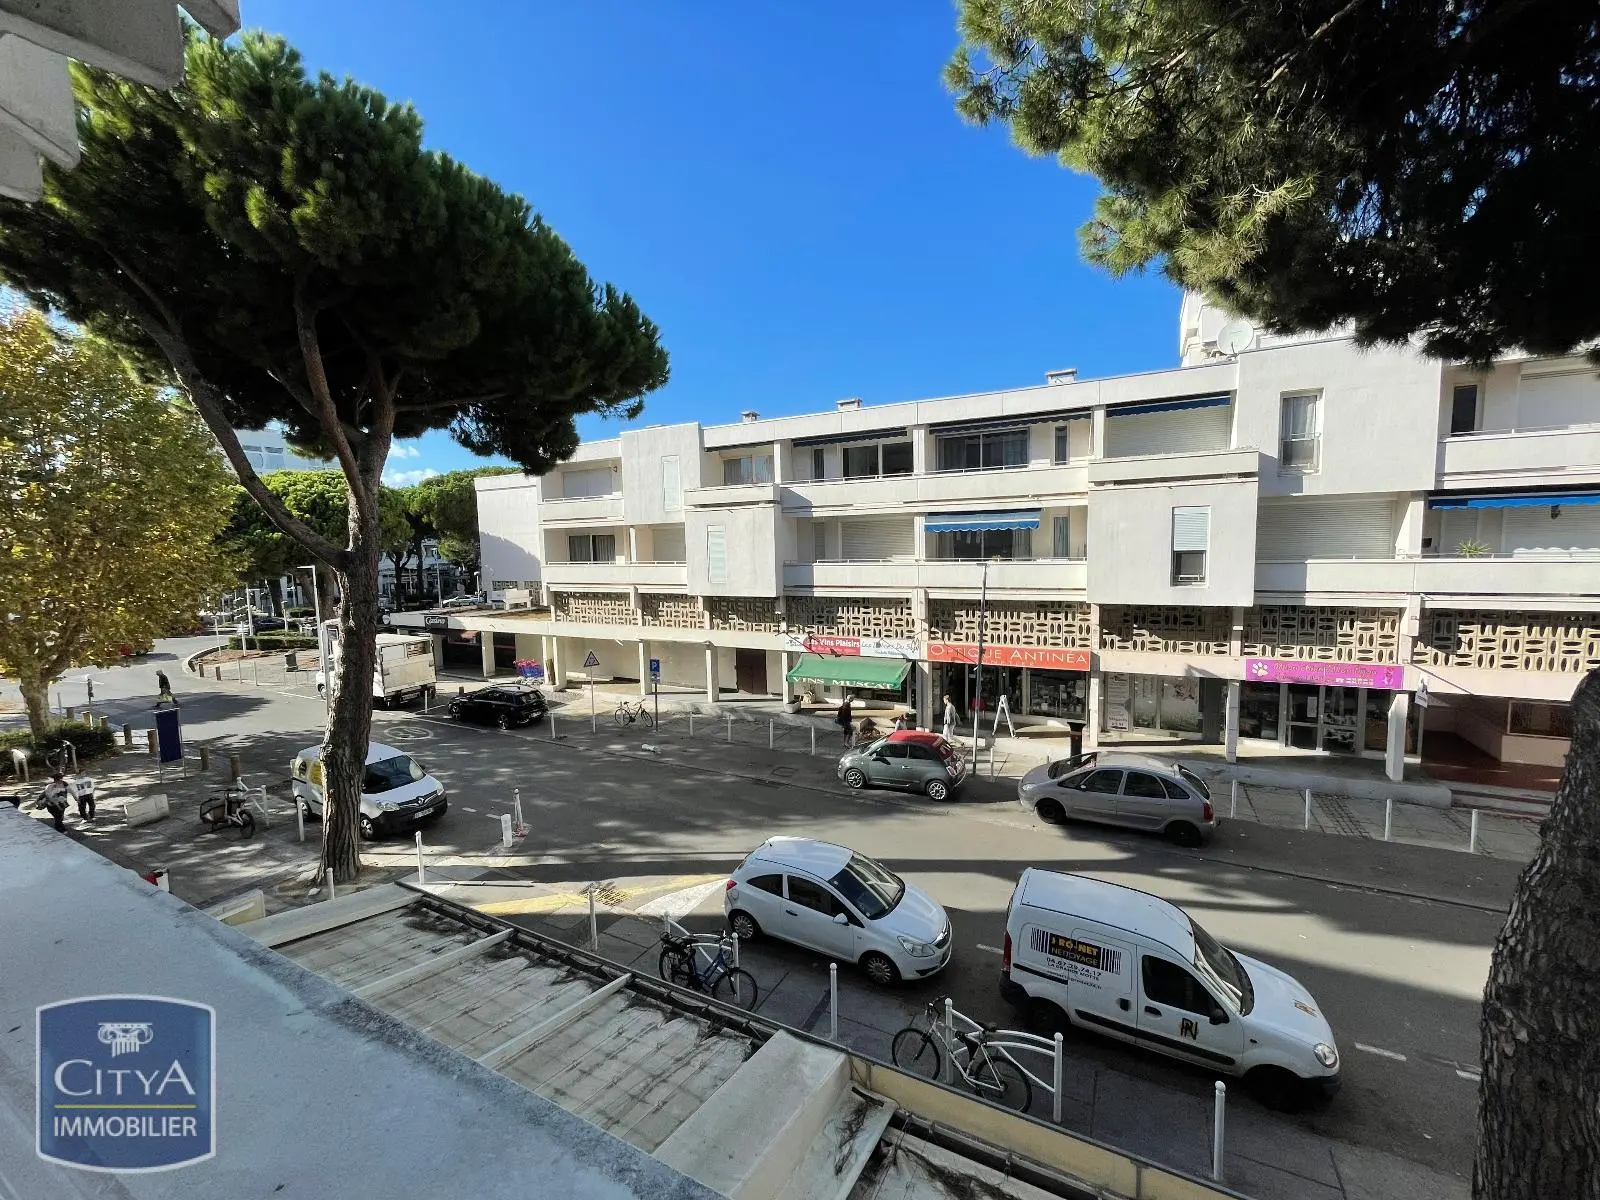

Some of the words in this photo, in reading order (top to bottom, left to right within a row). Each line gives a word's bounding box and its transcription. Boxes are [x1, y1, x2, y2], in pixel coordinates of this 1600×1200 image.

[819, 638, 834, 647] Vins
[835, 639, 861, 649] Plaisirs
[930, 644, 1002, 659] OPTIQUE
[792, 677, 825, 685] VINS
[832, 679, 895, 689] MUSCAT
[1051, 947, 1099, 966] NETTOYAGE
